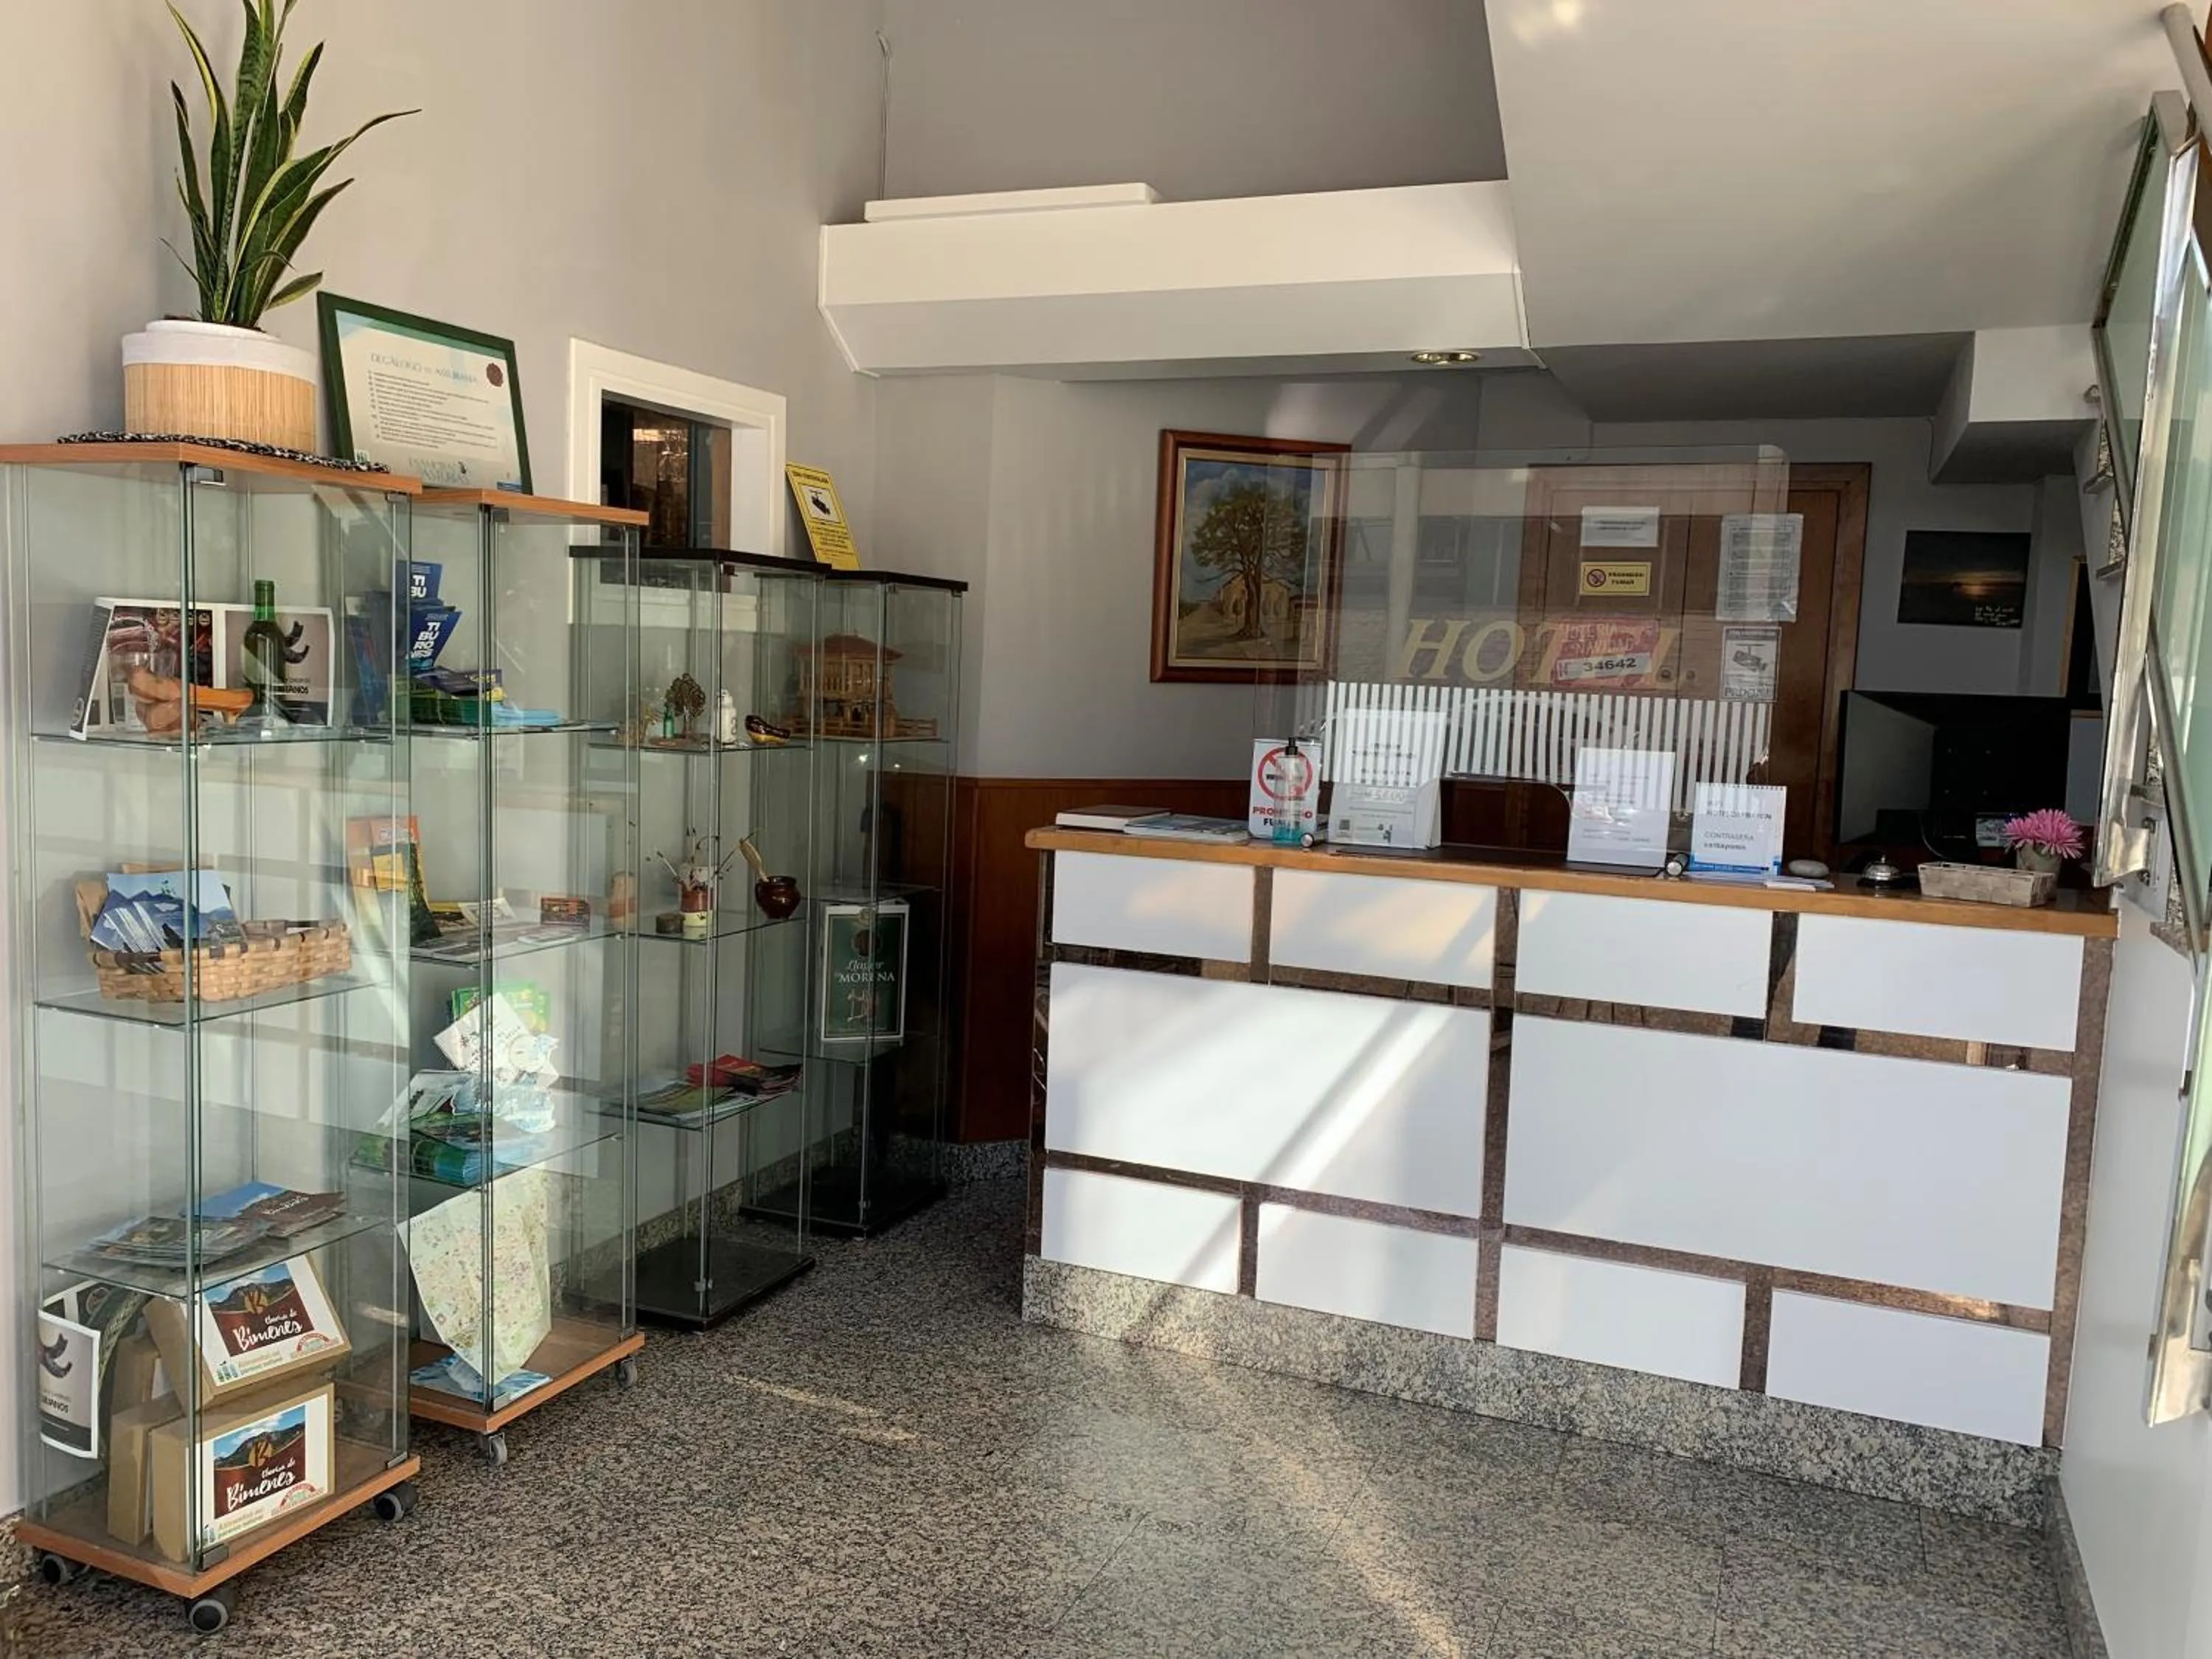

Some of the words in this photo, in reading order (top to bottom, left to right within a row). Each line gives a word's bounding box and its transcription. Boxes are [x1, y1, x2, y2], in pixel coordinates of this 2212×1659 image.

[1392, 618, 1684, 691] HOTL
[1582, 657, 1637, 672] 34642
[838, 972, 895, 983] MORENA
